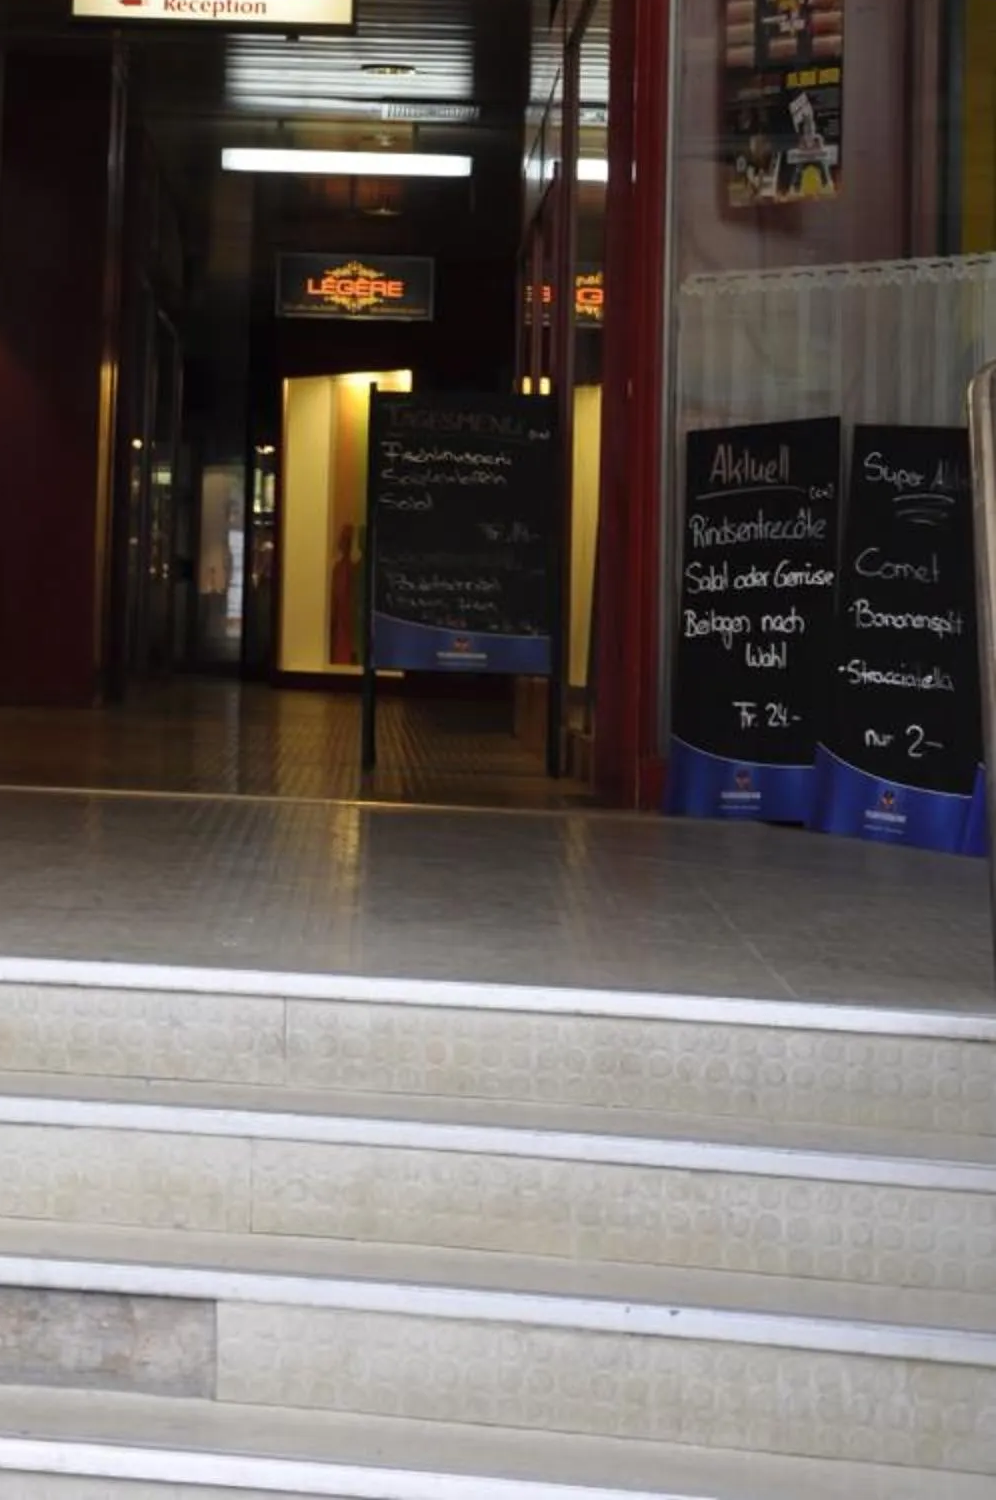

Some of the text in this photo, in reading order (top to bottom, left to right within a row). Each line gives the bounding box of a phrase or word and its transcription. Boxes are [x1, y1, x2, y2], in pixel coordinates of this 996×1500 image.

[709, 444, 790, 485] Aktuell
[863, 451, 925, 493] Super
[733, 569, 769, 591] oder
[684, 605, 806, 649] Beilagen nach
[745, 641, 787, 669] Wahl
